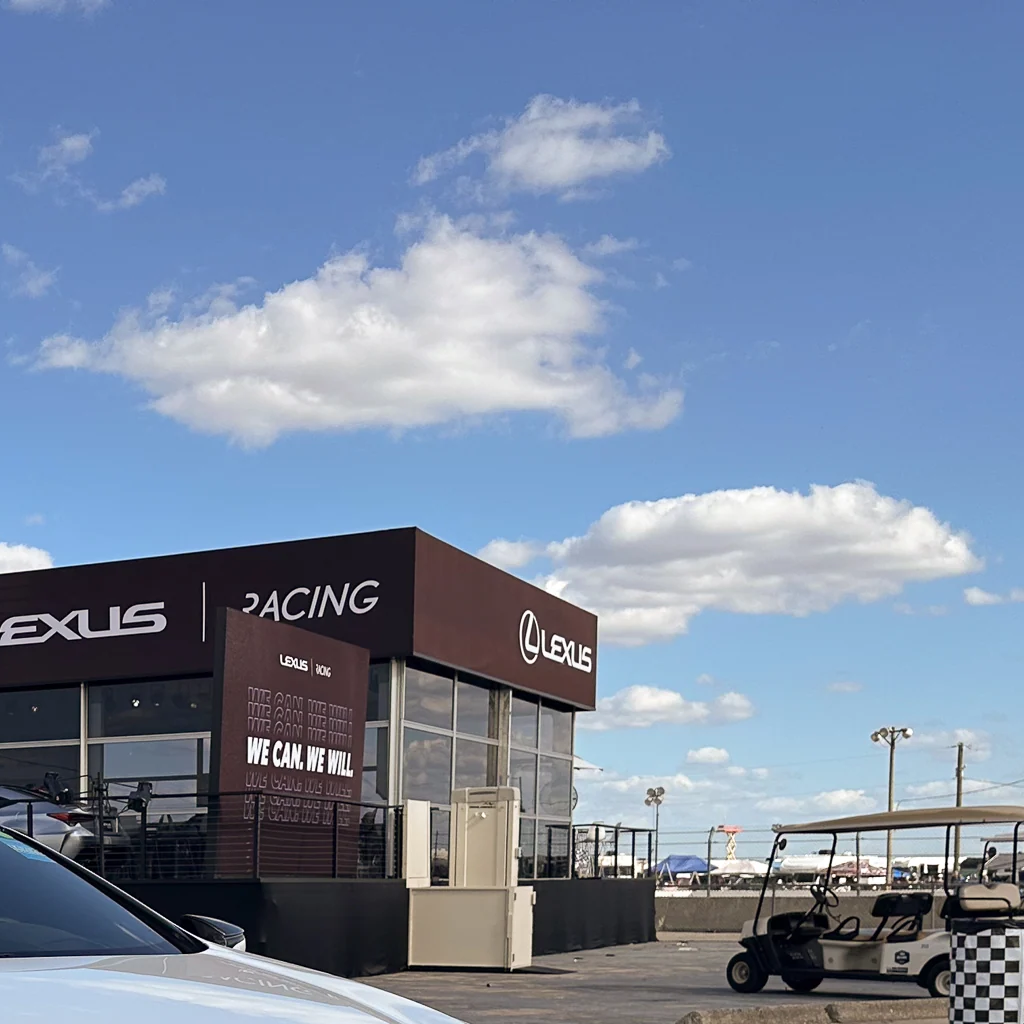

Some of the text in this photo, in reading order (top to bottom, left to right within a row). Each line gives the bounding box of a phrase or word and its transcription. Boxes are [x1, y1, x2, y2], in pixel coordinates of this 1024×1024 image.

[279, 654, 308, 671] LEXUS
[541, 629, 592, 673] LEXUS
[247, 737, 354, 778] WE CAN. WE WILL.
